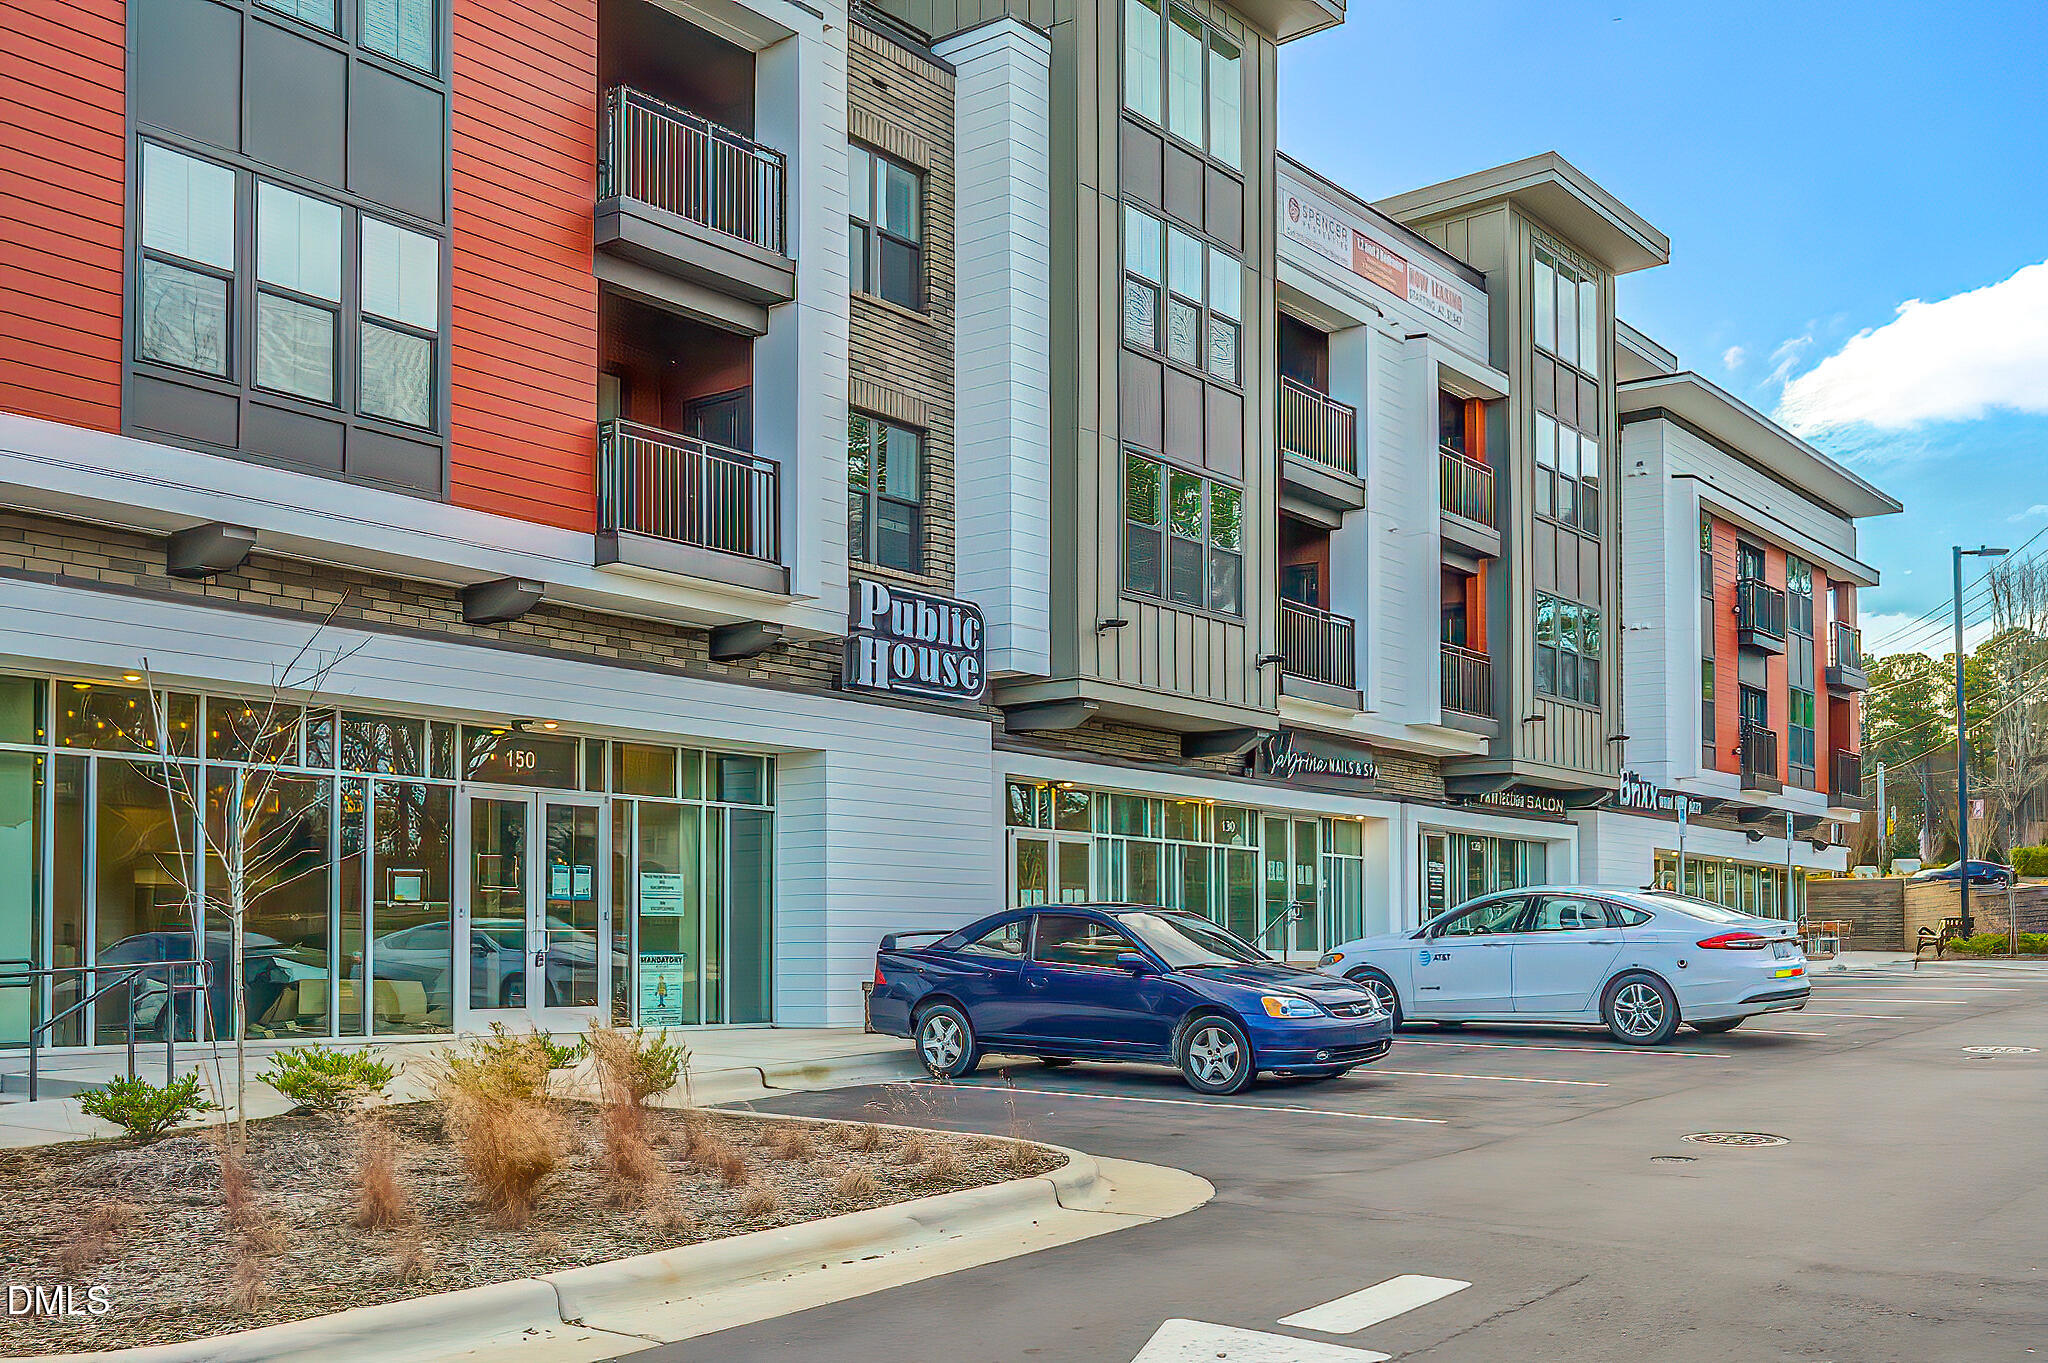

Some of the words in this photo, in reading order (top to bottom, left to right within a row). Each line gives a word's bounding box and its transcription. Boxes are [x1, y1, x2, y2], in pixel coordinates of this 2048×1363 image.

[1303, 205, 1348, 241] SPENCER
[1409, 267, 1428, 293] NOW
[858, 578, 981, 651] Public
[857, 635, 980, 690] House
[506, 749, 536, 770] 150
[1268, 731, 1328, 779] Sabrina
[1329, 758, 1354, 775] NAILS
[1356, 762, 1362, 776] &
[1363, 763, 1380, 779] SPA
[1619, 767, 1658, 810] Brixx
[1526, 795, 1565, 813] SALON
[1222, 820, 1236, 833] 130
[640, 956, 683, 964] MANDATORY
[1433, 953, 1451, 961] AT&T
